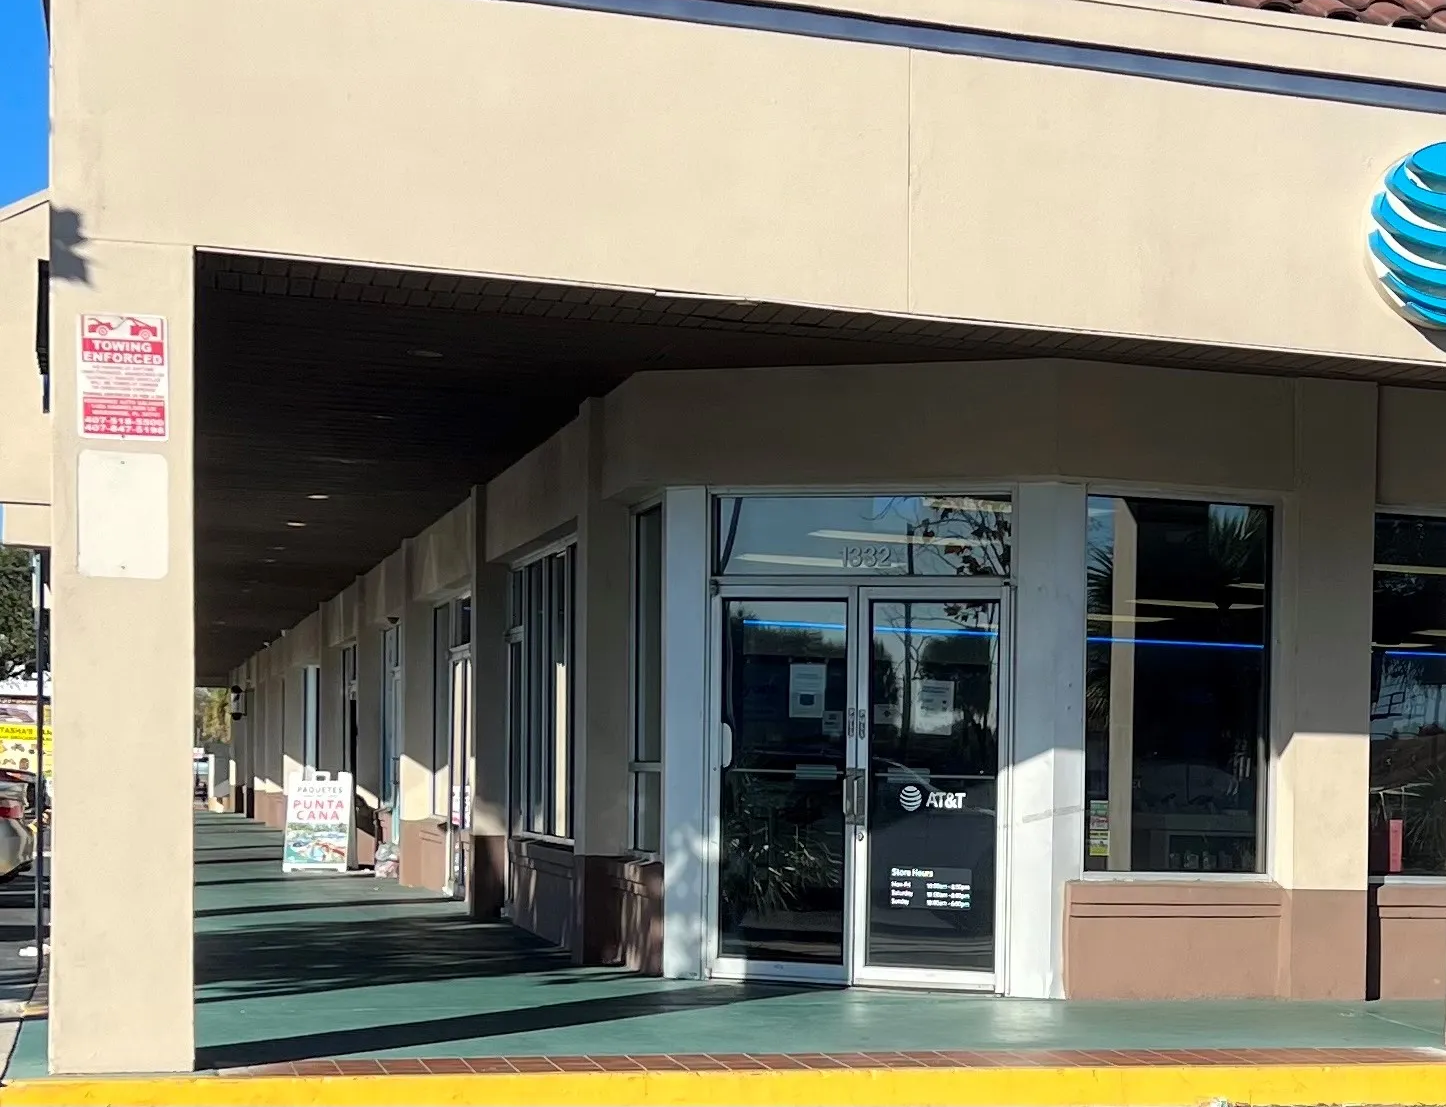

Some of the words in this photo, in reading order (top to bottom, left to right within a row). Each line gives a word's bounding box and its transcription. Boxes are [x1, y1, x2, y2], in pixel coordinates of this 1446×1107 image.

[91, 340, 152, 353] TOWING
[83, 352, 163, 365] ENFORCED
[839, 546, 891, 567] 1332
[297, 786, 343, 794] PAQUETES
[293, 799, 344, 809] PUNTA
[925, 791, 967, 809] AT&T
[296, 810, 340, 821] CANA
[891, 867, 912, 877] Store
[912, 868, 934, 878] Hours
